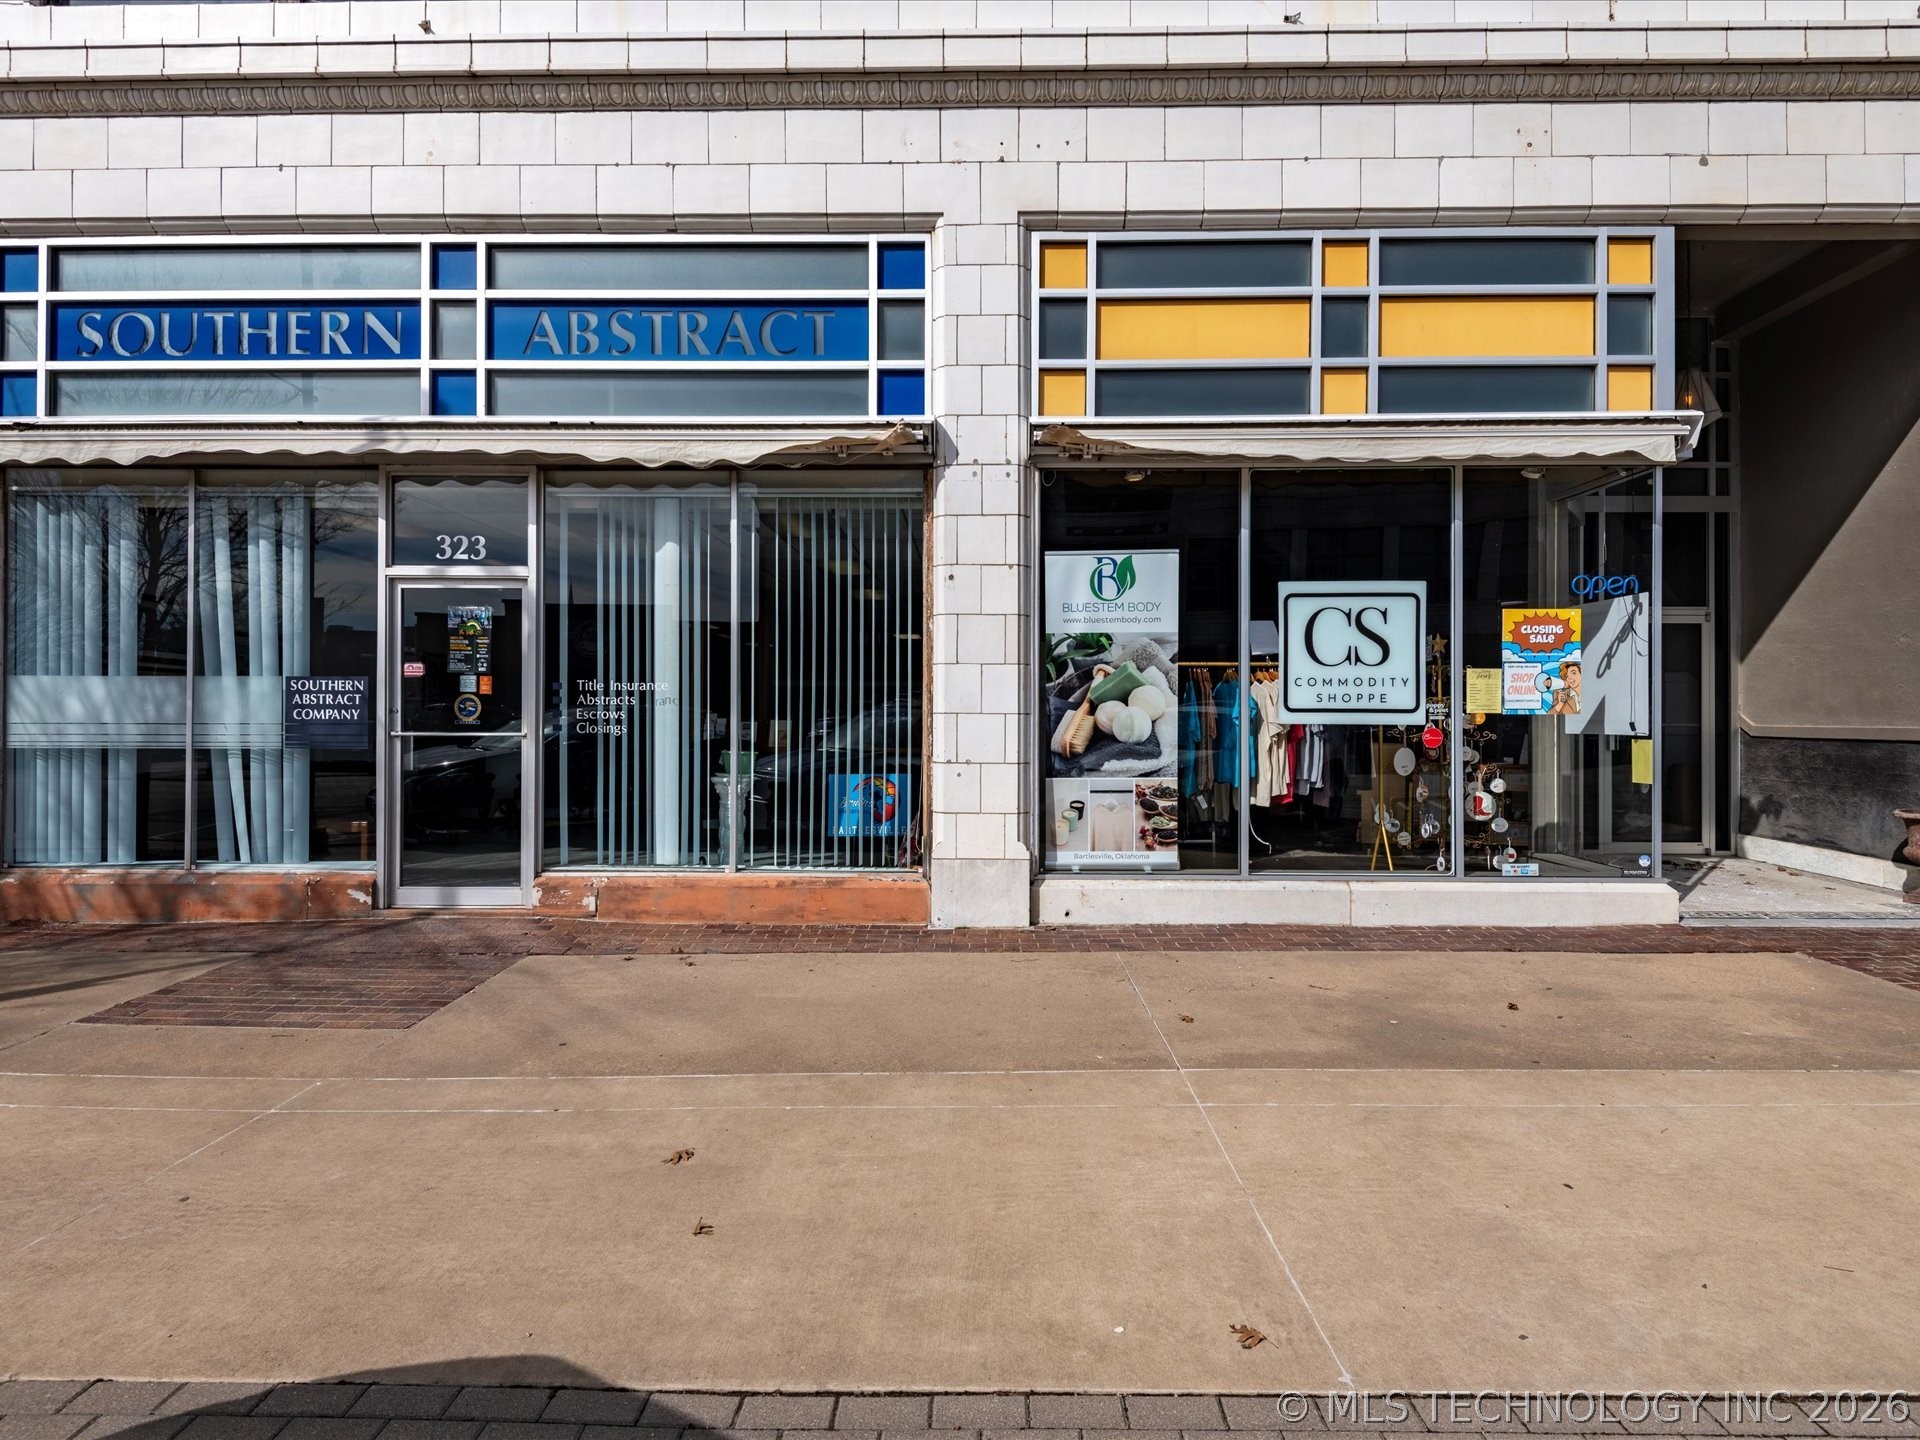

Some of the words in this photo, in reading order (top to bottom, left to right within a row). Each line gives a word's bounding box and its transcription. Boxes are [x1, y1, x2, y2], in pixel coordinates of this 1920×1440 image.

[76, 310, 403, 357] SOUTHERN
[523, 309, 836, 356] ABSTRACT
[436, 534, 487, 560] 323
[1062, 602, 1124, 613] BLUESTEM
[1127, 602, 1161, 612] BODY
[1063, 616, 1161, 625] www.bluestembody.com
[1304, 607, 1390, 667] CS
[1294, 677, 1409, 687] COMMODITY
[1510, 672, 1535, 683] SHOP
[290, 679, 364, 691] SOUTHERN
[576, 679, 605, 691] Title
[610, 680, 669, 691] Insurance
[1507, 685, 1538, 695] ONLINE
[292, 693, 361, 705] ABSTRACT
[576, 693, 636, 705] Abstracts
[1316, 693, 1387, 703] SHOPPE
[293, 708, 360, 720] COMPANY
[576, 708, 626, 720] Escrows
[576, 722, 628, 736] Closings
